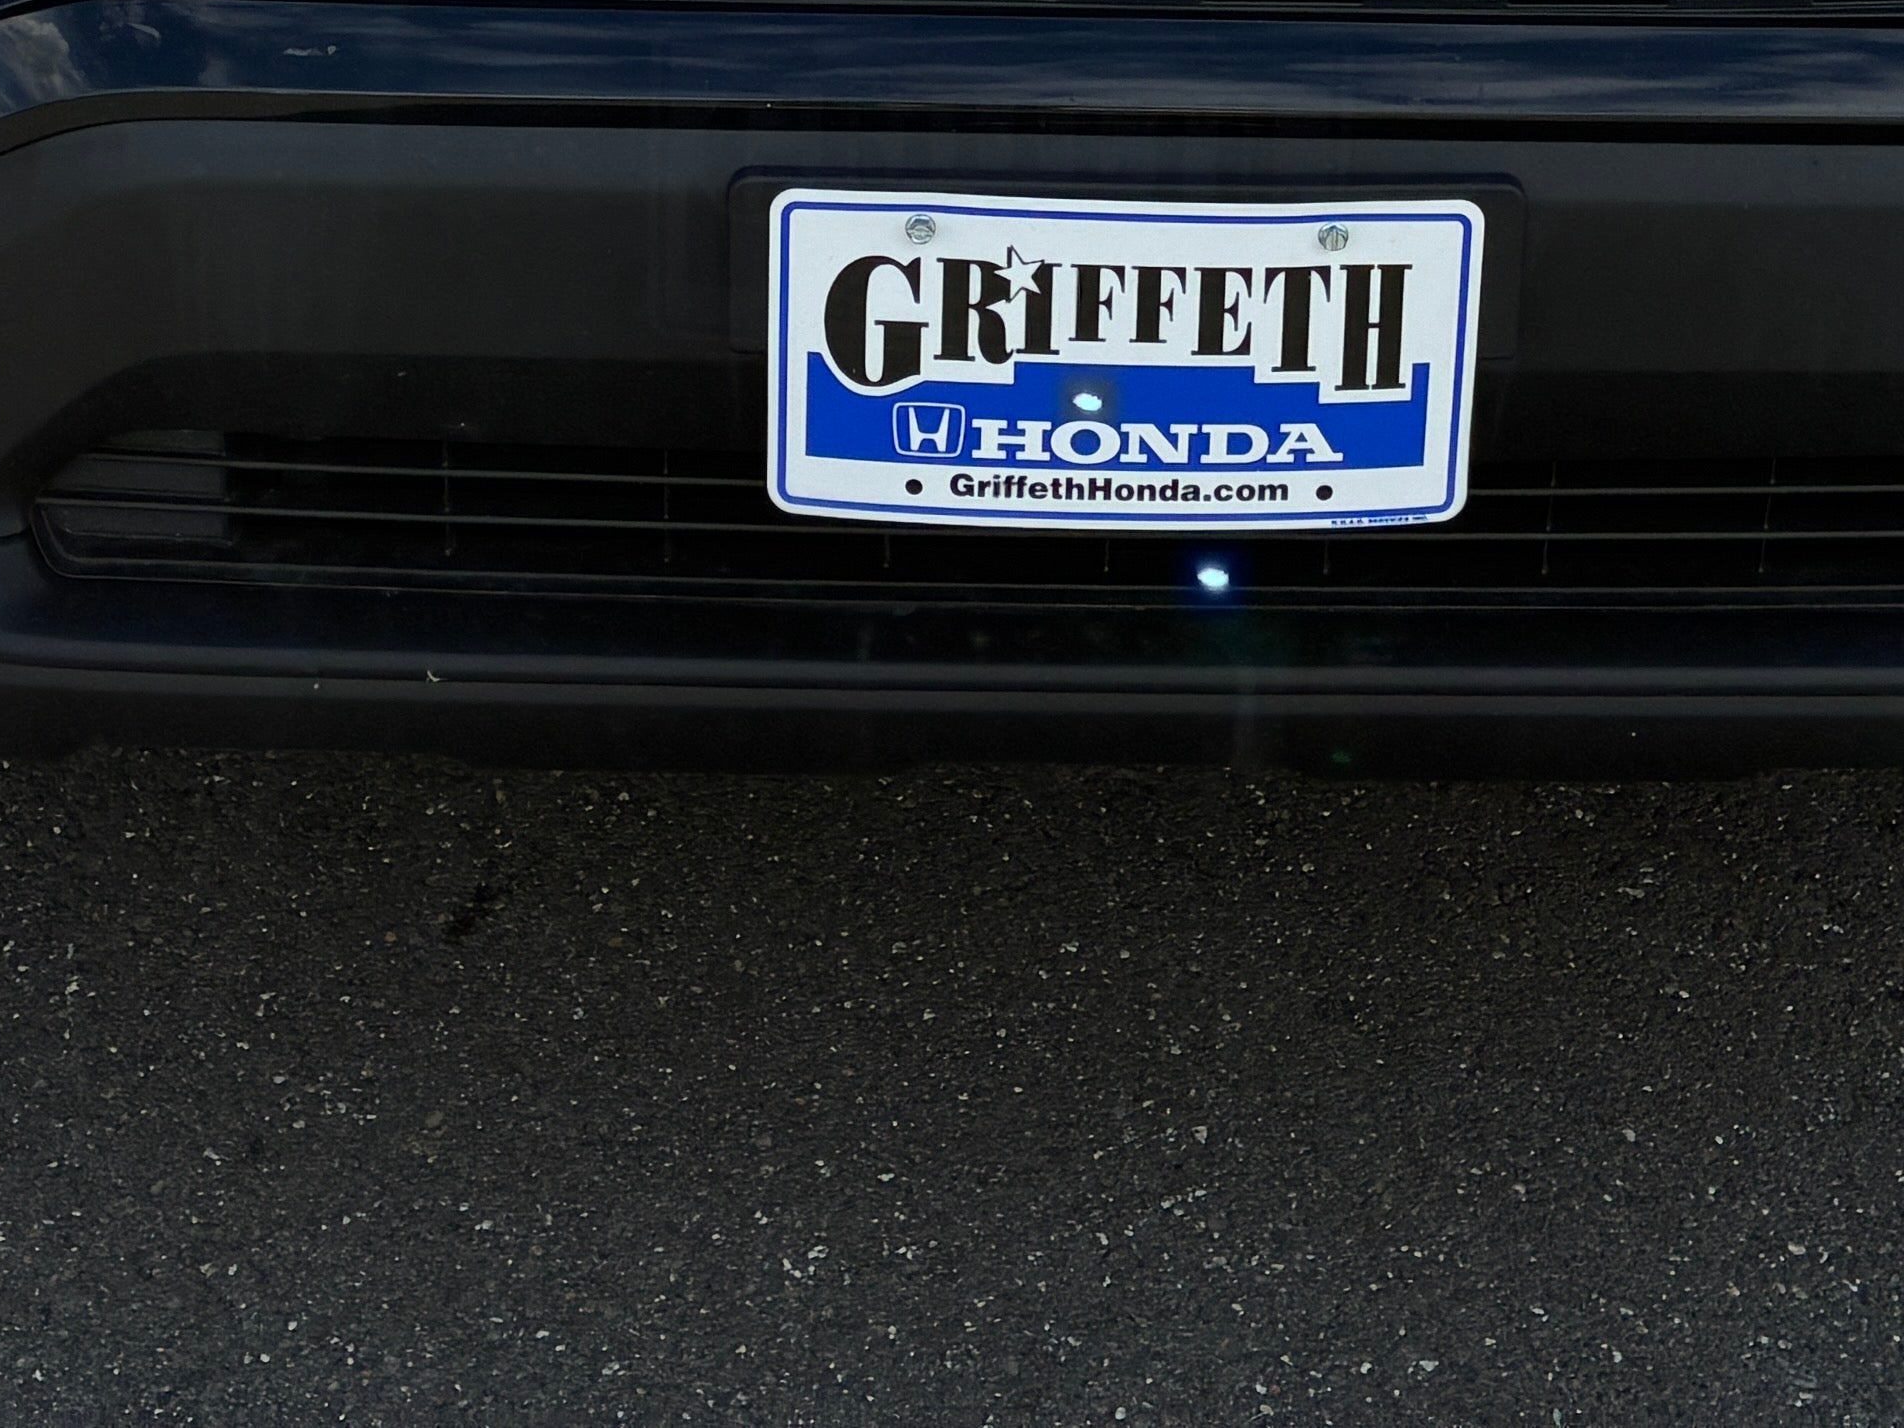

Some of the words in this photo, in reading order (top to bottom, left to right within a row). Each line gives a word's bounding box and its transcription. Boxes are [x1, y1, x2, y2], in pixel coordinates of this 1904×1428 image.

[823, 254, 1413, 391] GRIFFETH
[971, 418, 1344, 465] HONDA
[949, 473, 1290, 502] GriffethHonda.com
